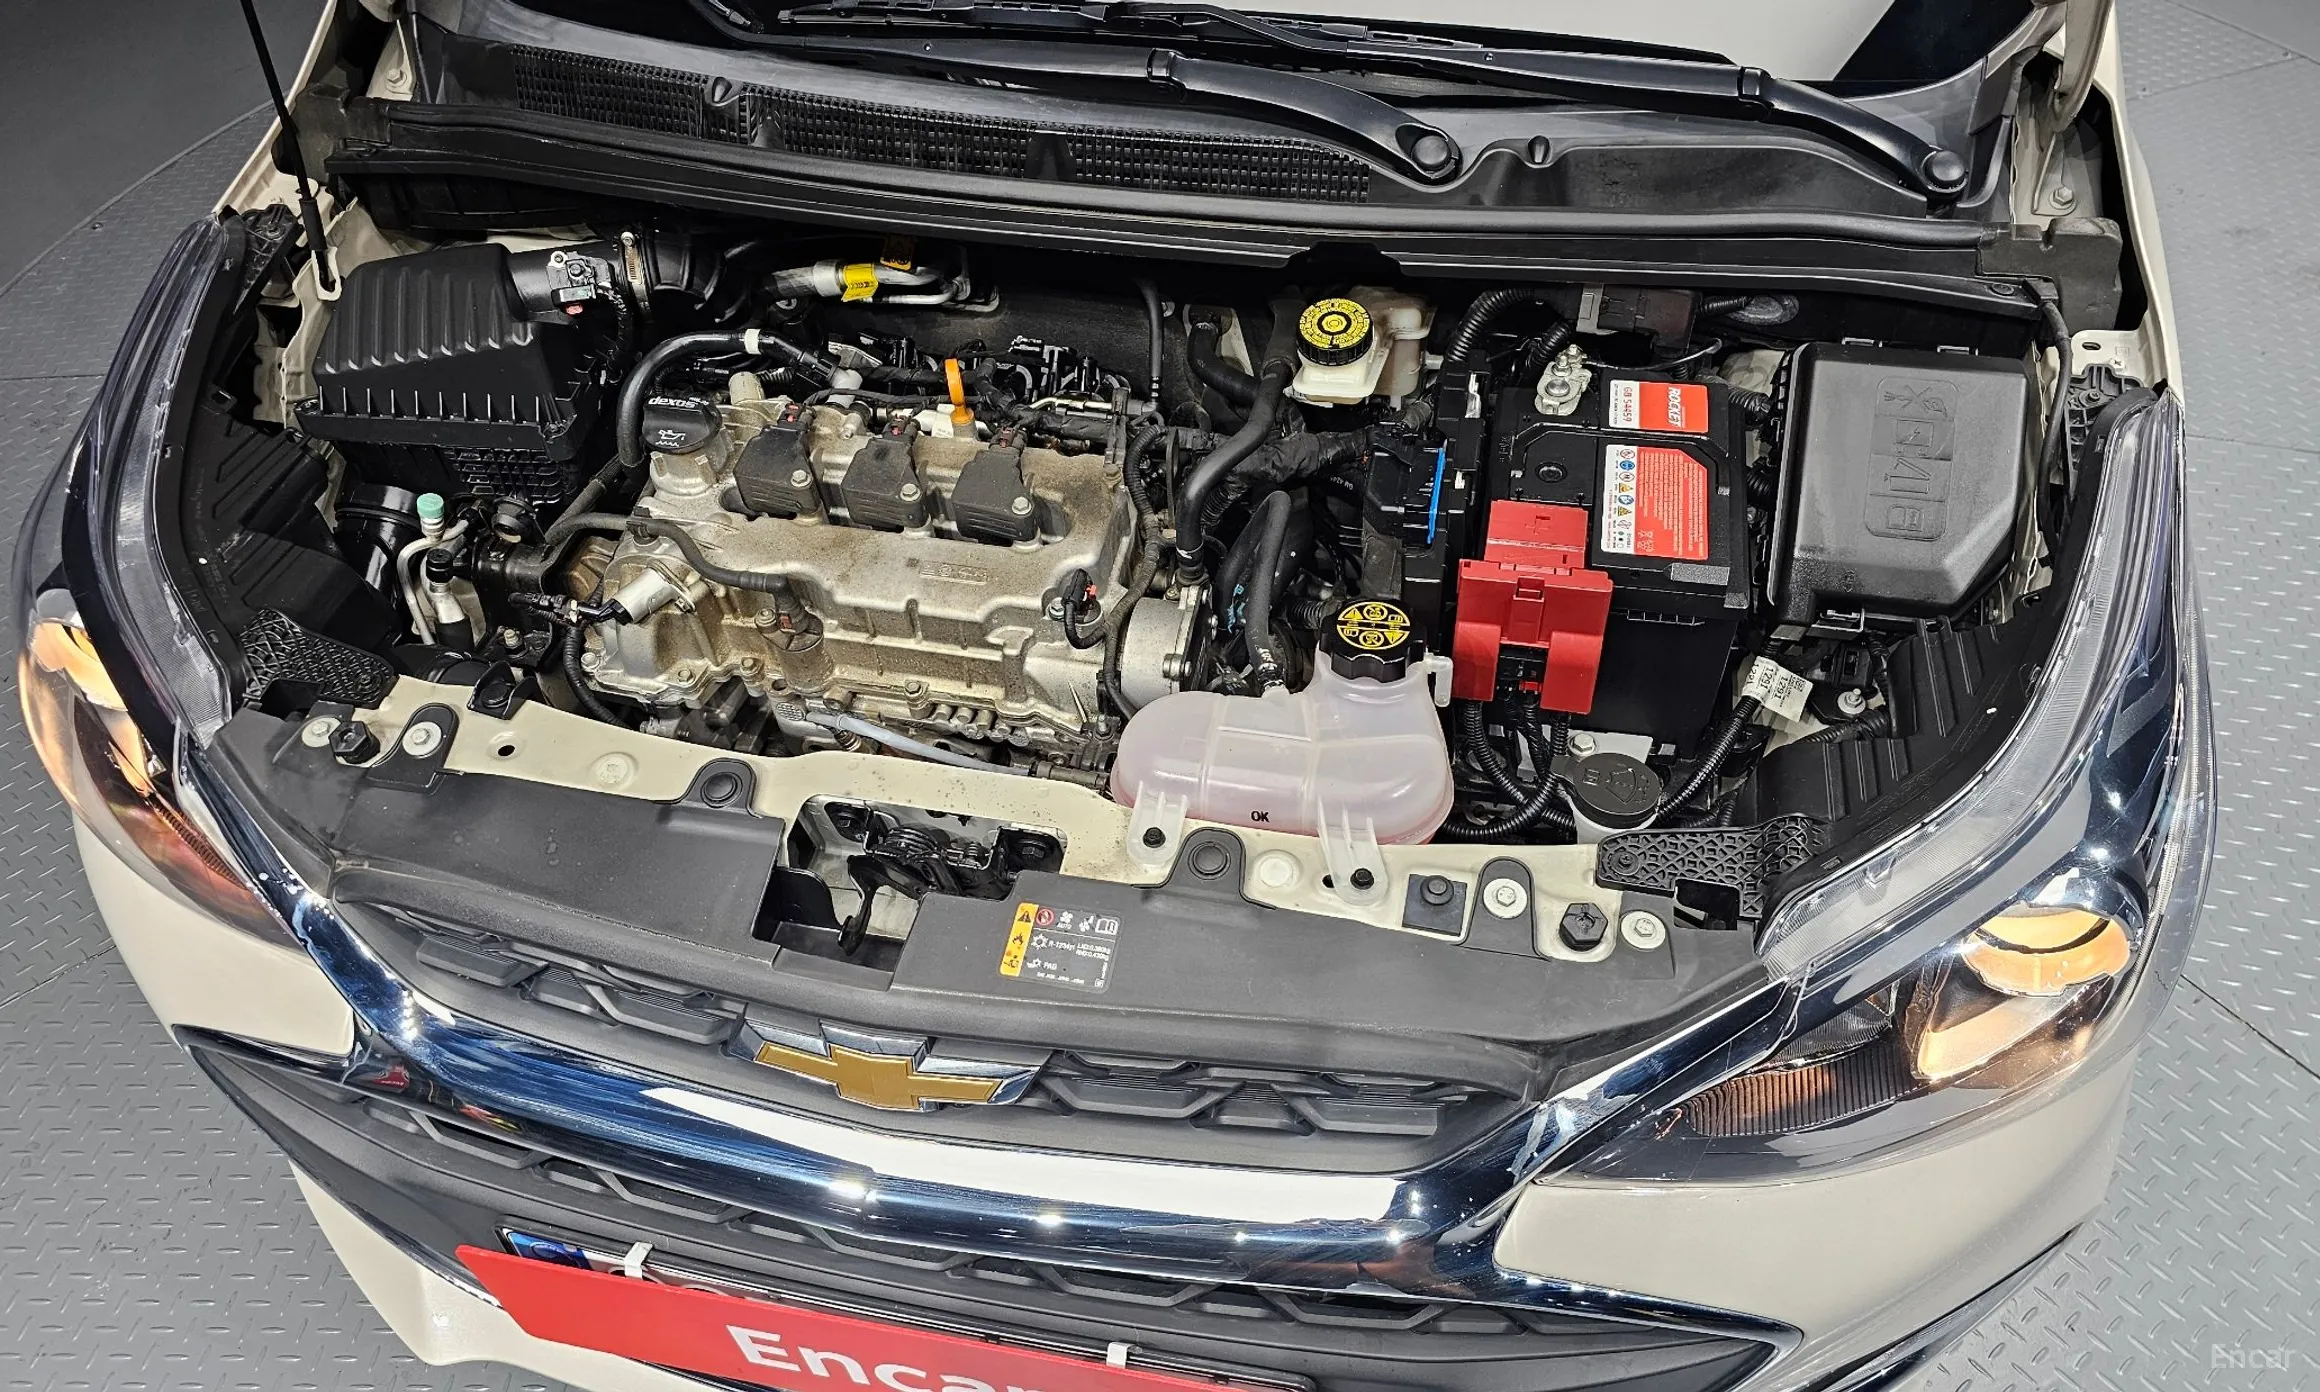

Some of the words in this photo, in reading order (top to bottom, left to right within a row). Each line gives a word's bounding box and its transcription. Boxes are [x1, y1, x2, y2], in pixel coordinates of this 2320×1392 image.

[648, 396, 698, 408] dexos
[1667, 386, 1682, 428] ROCKET
[1760, 666, 1774, 689] 1291
[1774, 676, 1789, 699] 1291
[1251, 810, 1270, 822] OK
